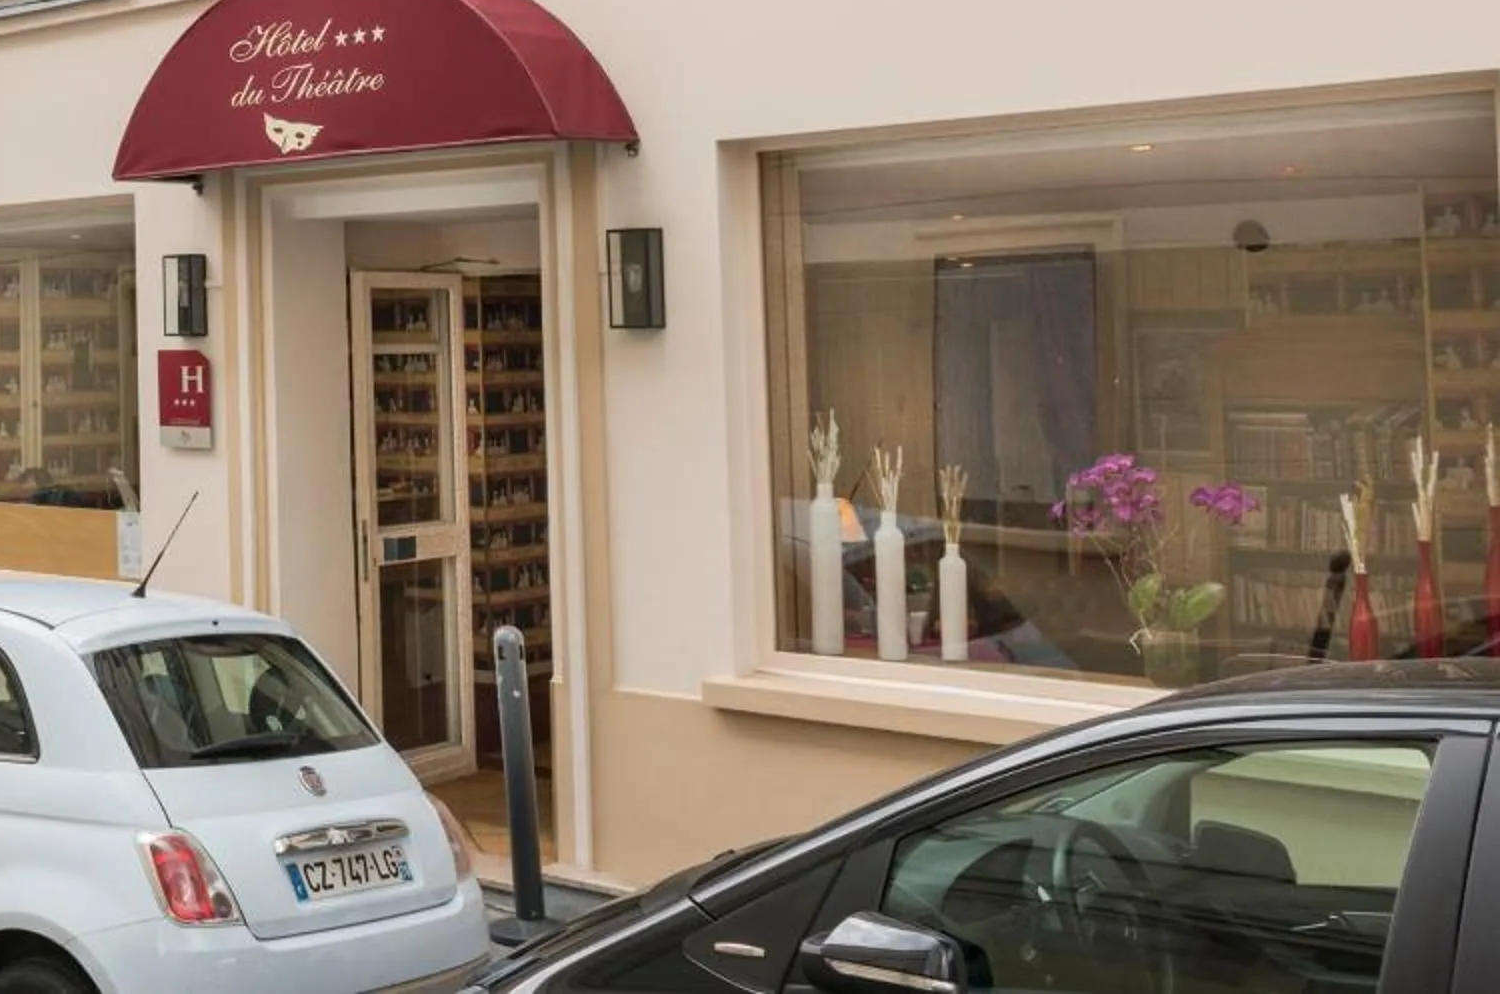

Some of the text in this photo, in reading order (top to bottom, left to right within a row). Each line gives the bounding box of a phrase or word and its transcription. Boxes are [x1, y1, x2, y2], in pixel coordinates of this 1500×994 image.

[229, 18, 333, 63] Hôtel
[231, 63, 385, 107] du Théâtre
[180, 366, 204, 393] H
